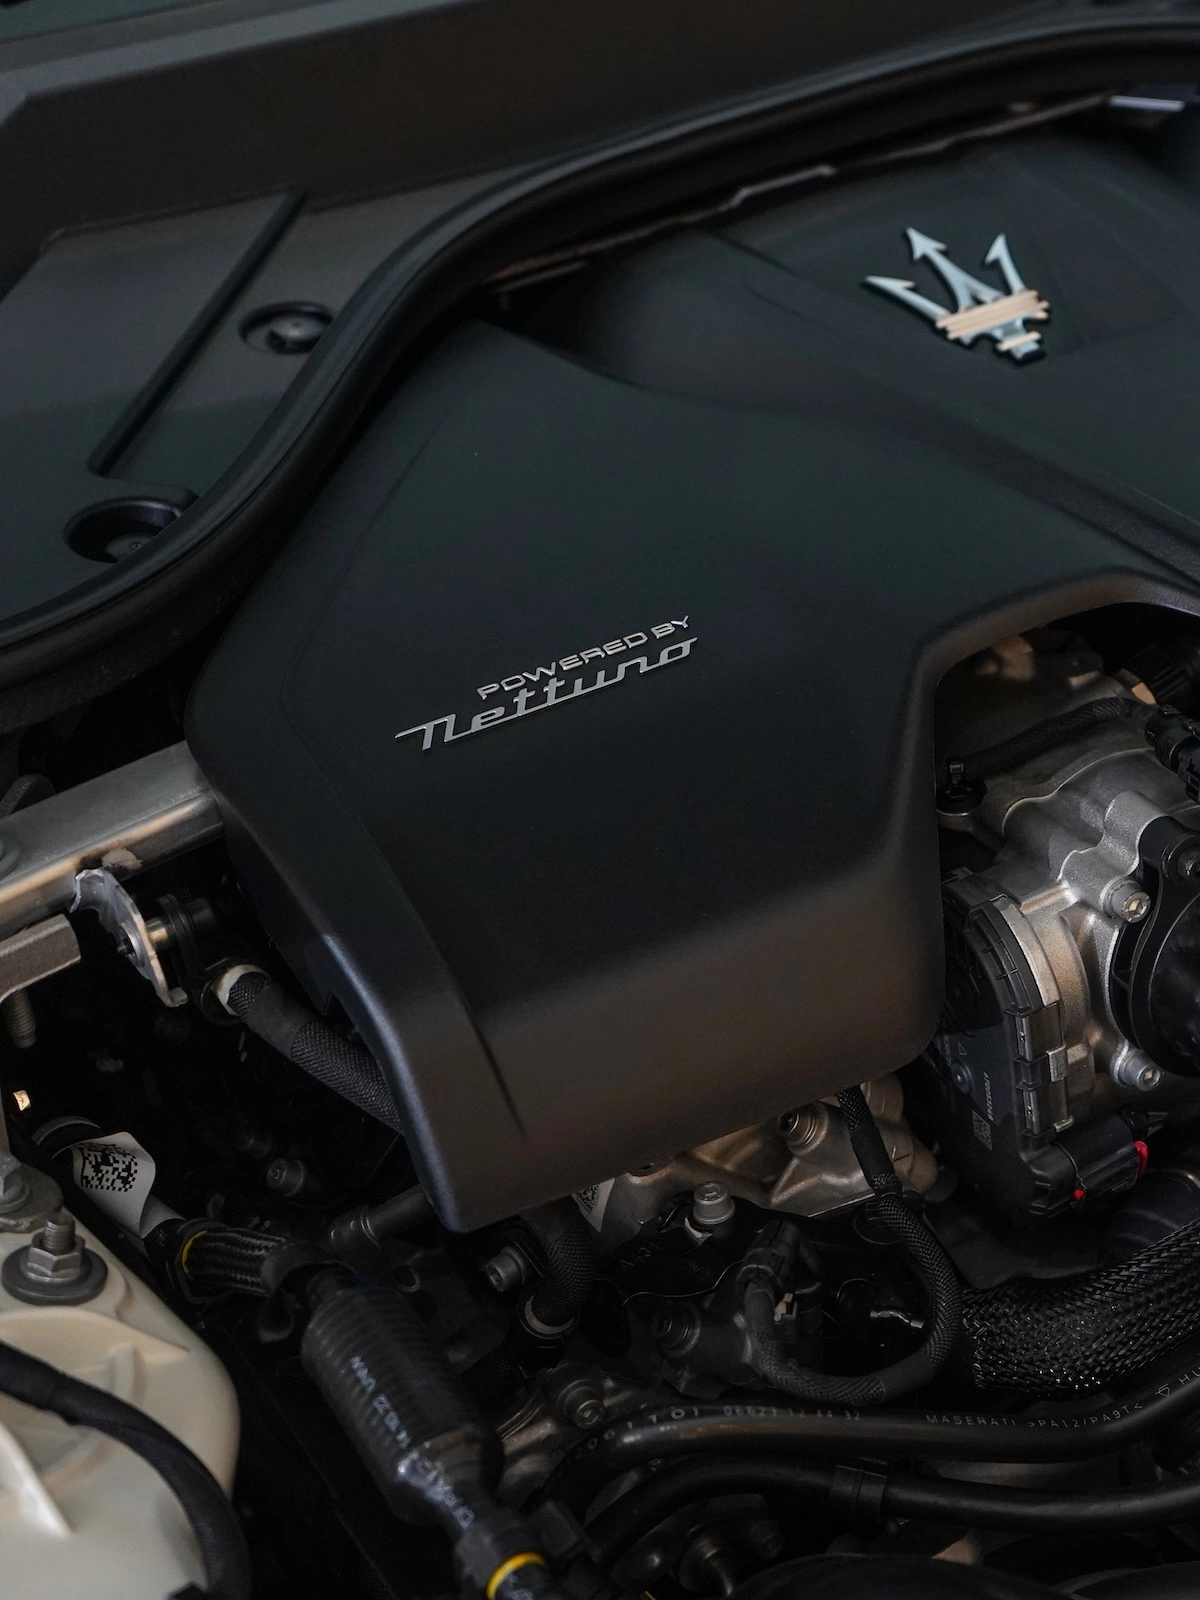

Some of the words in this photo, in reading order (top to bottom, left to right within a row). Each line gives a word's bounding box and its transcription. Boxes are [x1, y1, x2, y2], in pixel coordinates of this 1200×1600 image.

[394, 636, 698, 750] Nettuno
[477, 631, 648, 700] POWERED
[650, 615, 689, 640] BY
[925, 1414, 1016, 1427] MASERATI
